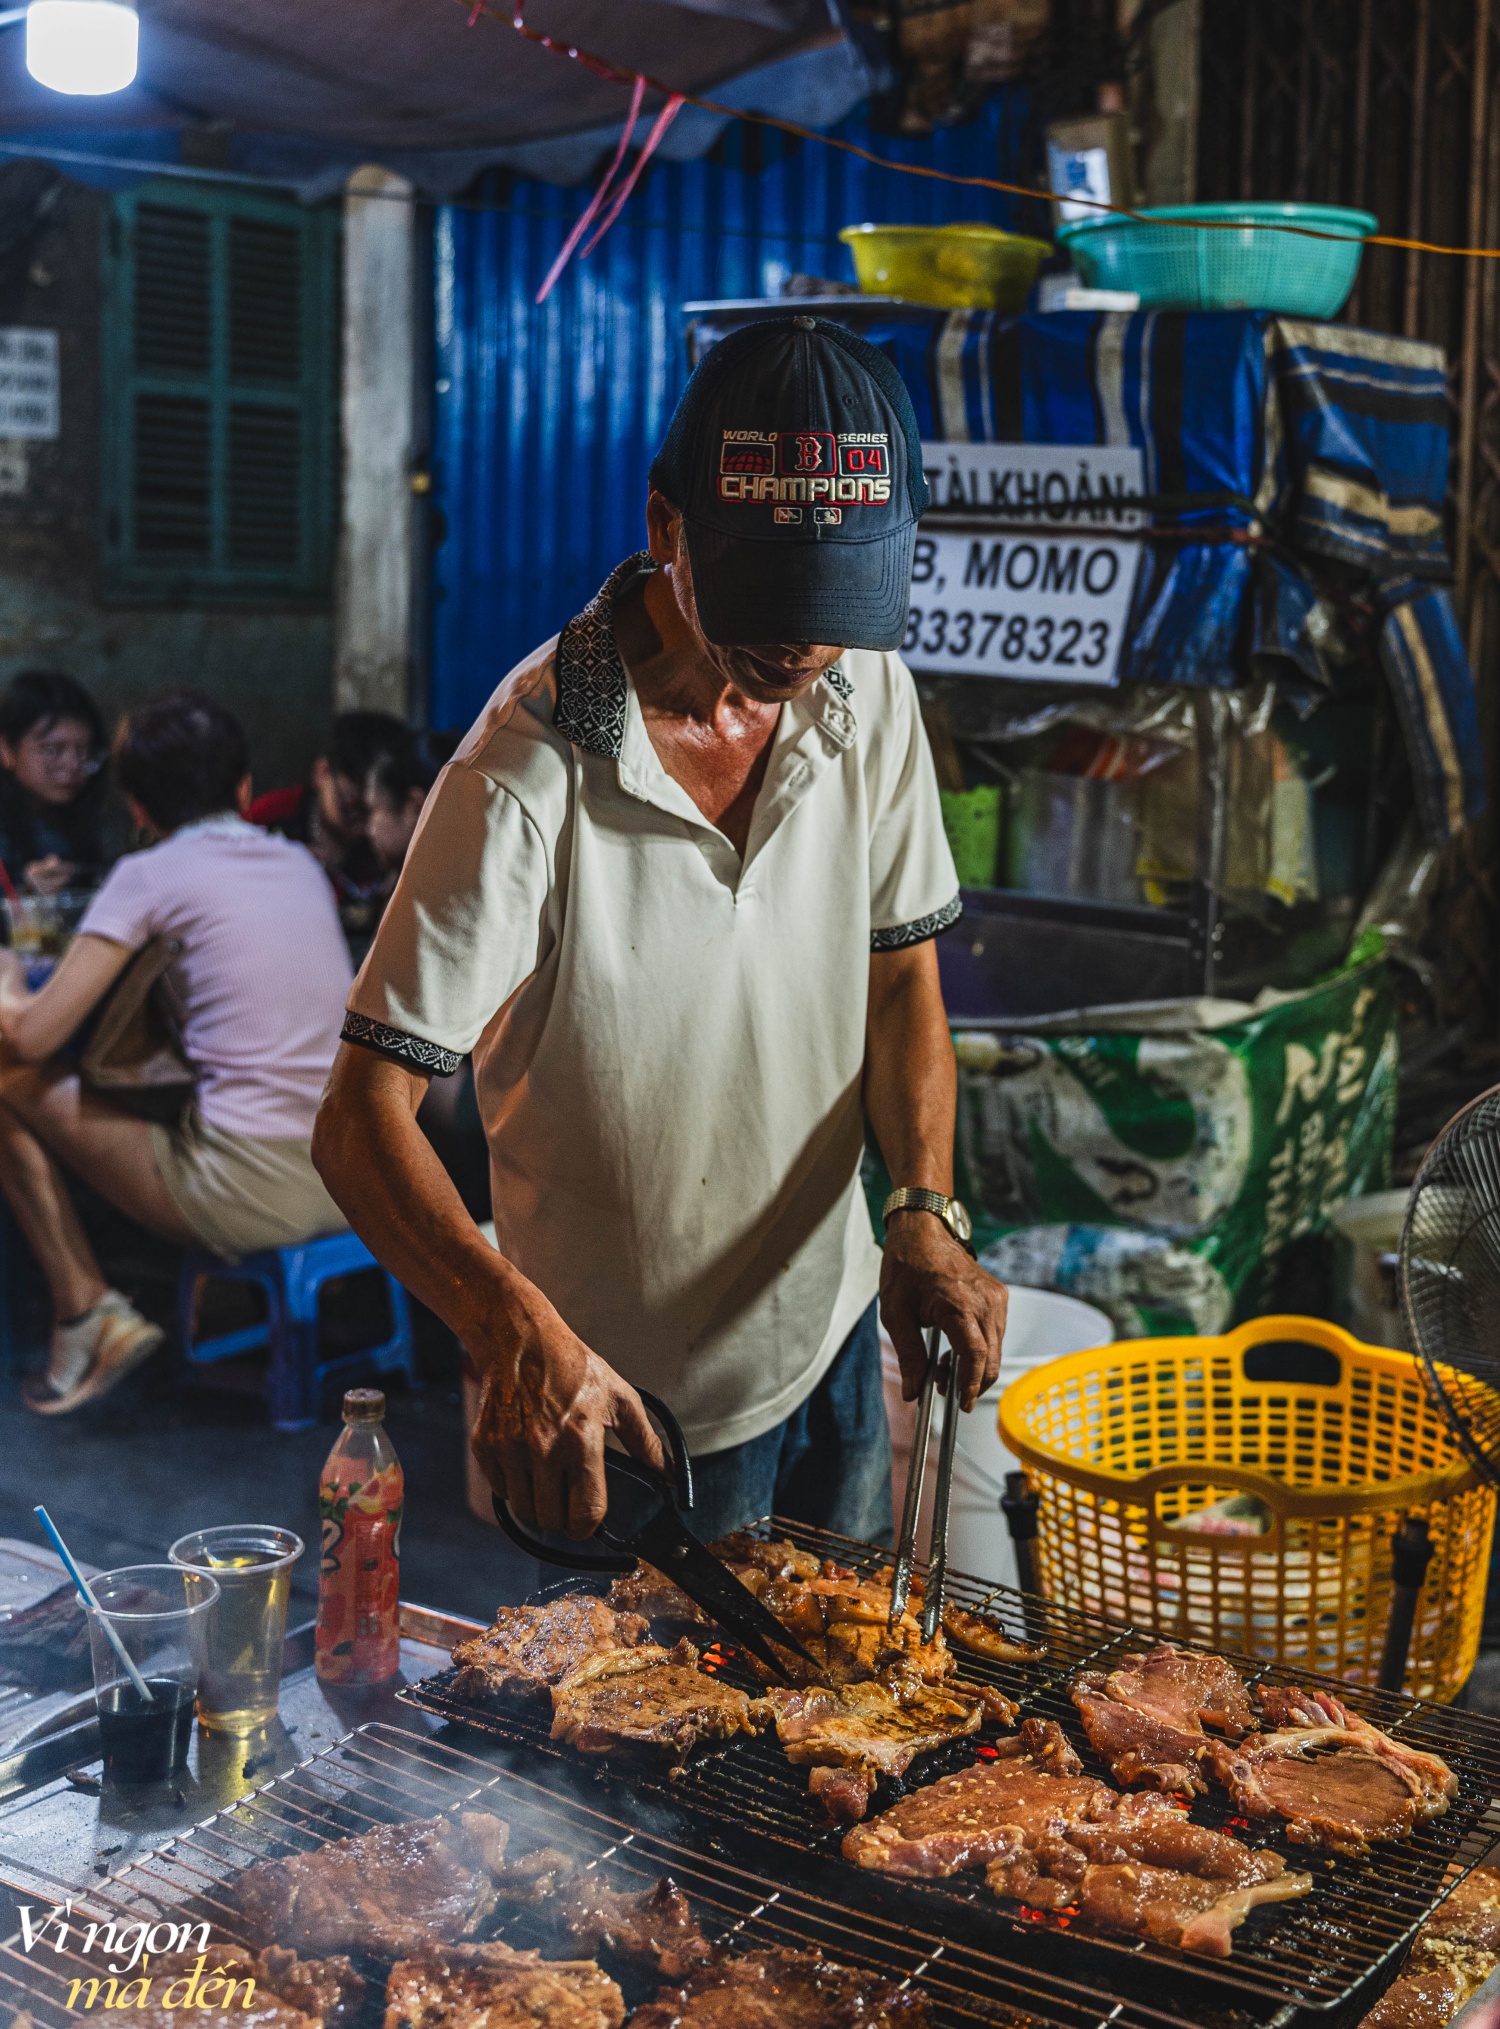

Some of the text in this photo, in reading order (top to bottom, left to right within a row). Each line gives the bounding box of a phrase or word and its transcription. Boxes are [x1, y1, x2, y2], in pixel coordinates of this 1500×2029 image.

[723, 429, 888, 443] WORLD SERIES
[795, 437, 822, 471] B
[848, 449, 882, 471] 04
[720, 477, 892, 504] CHAMPIONS
[964, 541, 1119, 596] MOMO
